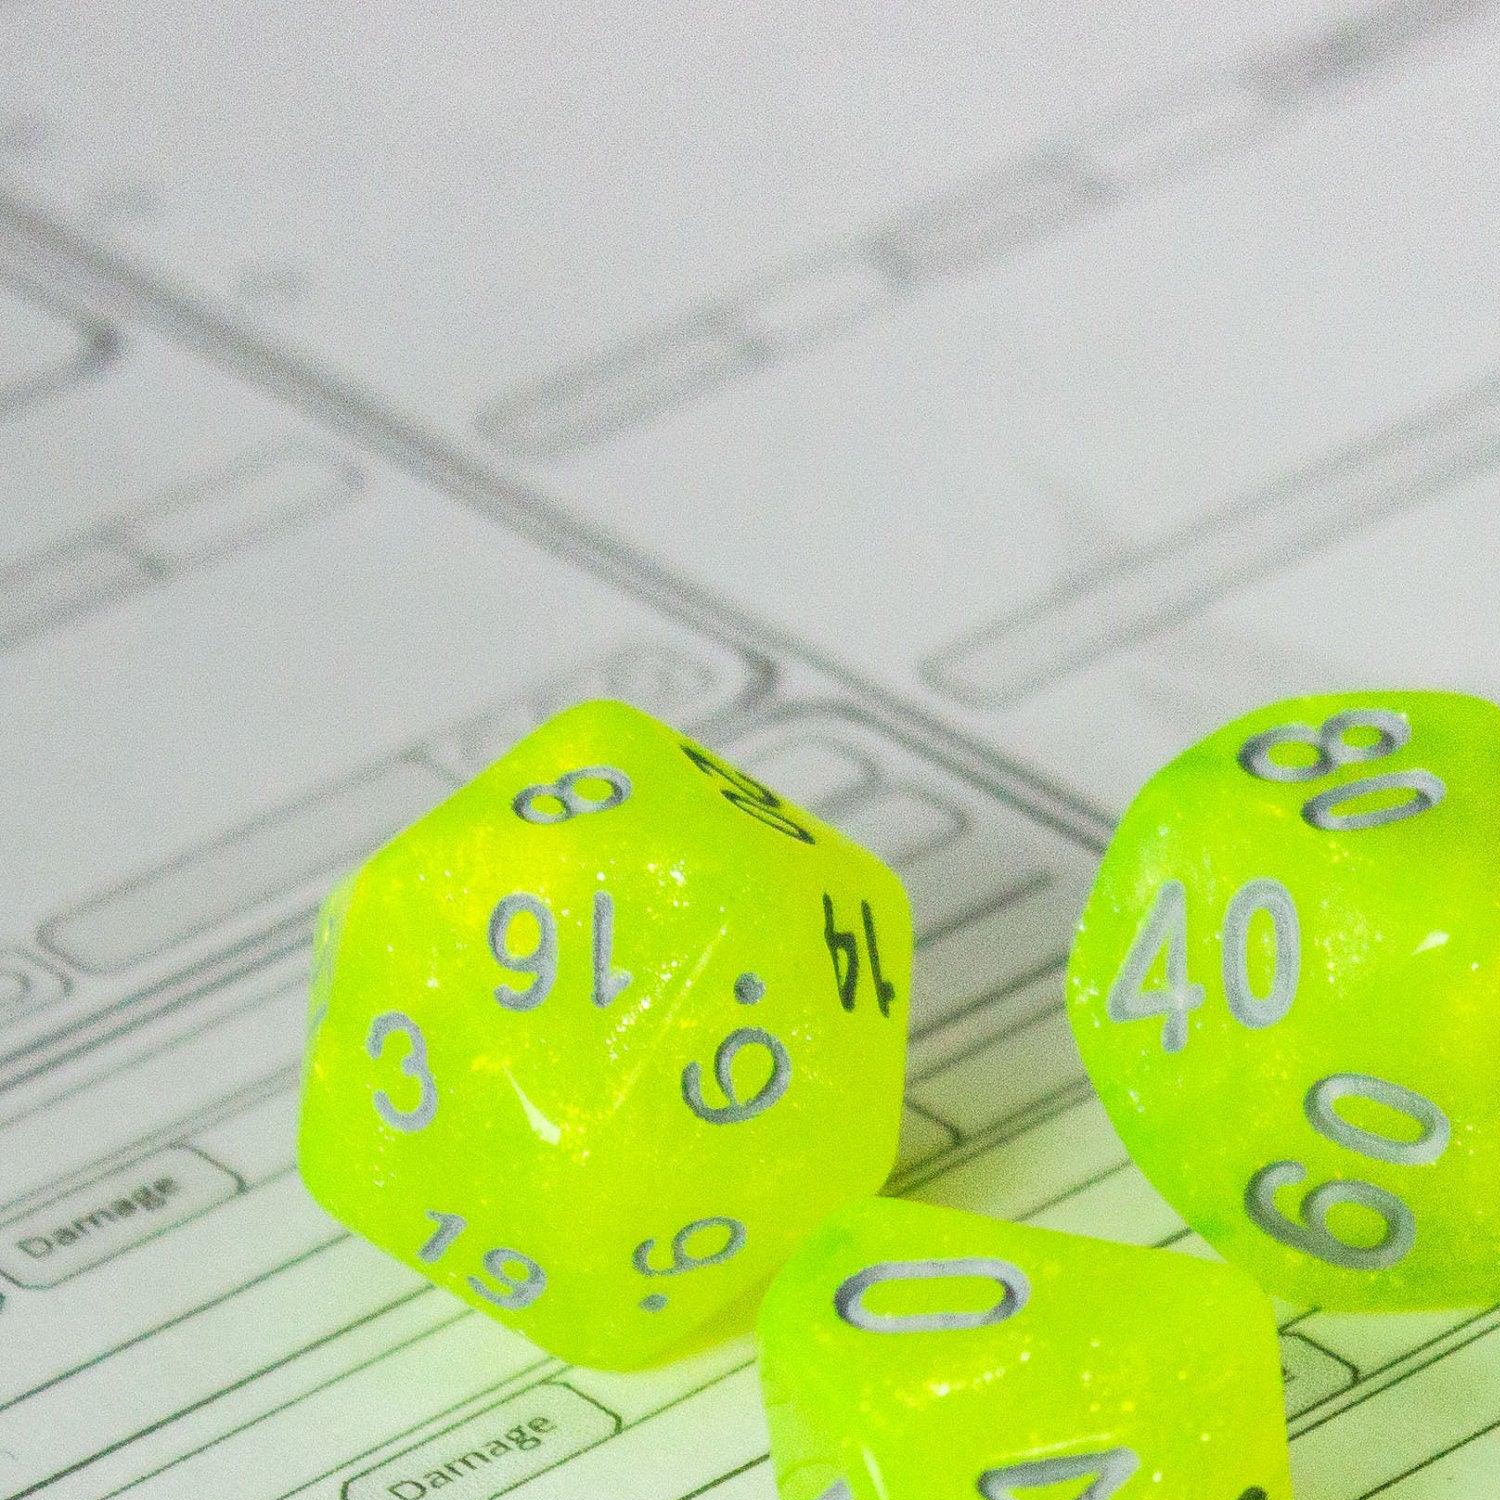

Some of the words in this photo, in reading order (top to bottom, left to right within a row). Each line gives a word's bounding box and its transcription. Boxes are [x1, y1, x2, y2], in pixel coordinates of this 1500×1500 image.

[512, 765, 632, 824] 8
[1237, 709, 1446, 831] 80
[488, 892, 633, 1012] 16
[822, 889, 895, 1019] 14
[1106, 877, 1302, 1054] 40
[366, 1010, 439, 1132] 3
[17, 1176, 180, 1259] Damage
[415, 1209, 548, 1309] 19
[833, 1256, 1031, 1334] 0
